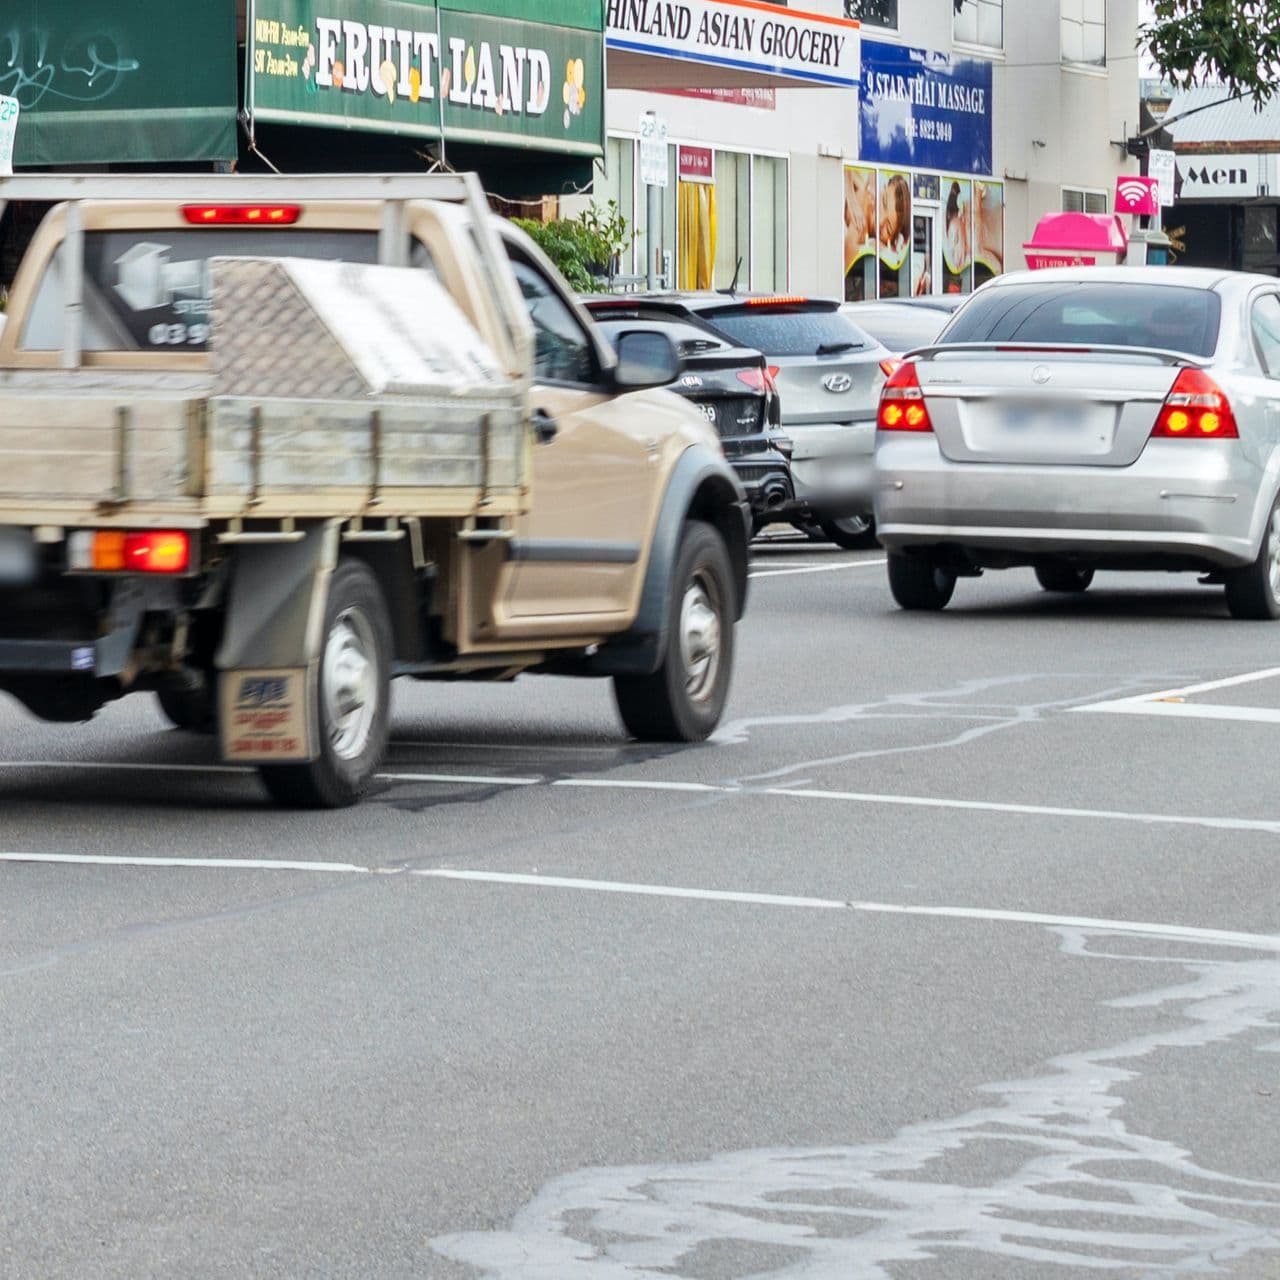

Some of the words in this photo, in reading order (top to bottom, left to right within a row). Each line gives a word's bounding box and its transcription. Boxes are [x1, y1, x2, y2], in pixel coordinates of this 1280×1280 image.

[696, 9, 757, 52] ASIAN
[759, 20, 847, 69] GROCERY
[315, 17, 439, 100] FRUIT
[448, 36, 552, 115] LAND
[1, 100, 17, 121] 2P
[876, 72, 907, 101] STAR
[908, 73, 935, 106] THAI
[937, 81, 986, 116] MASSAGE
[1186, 165, 1248, 186] Men
